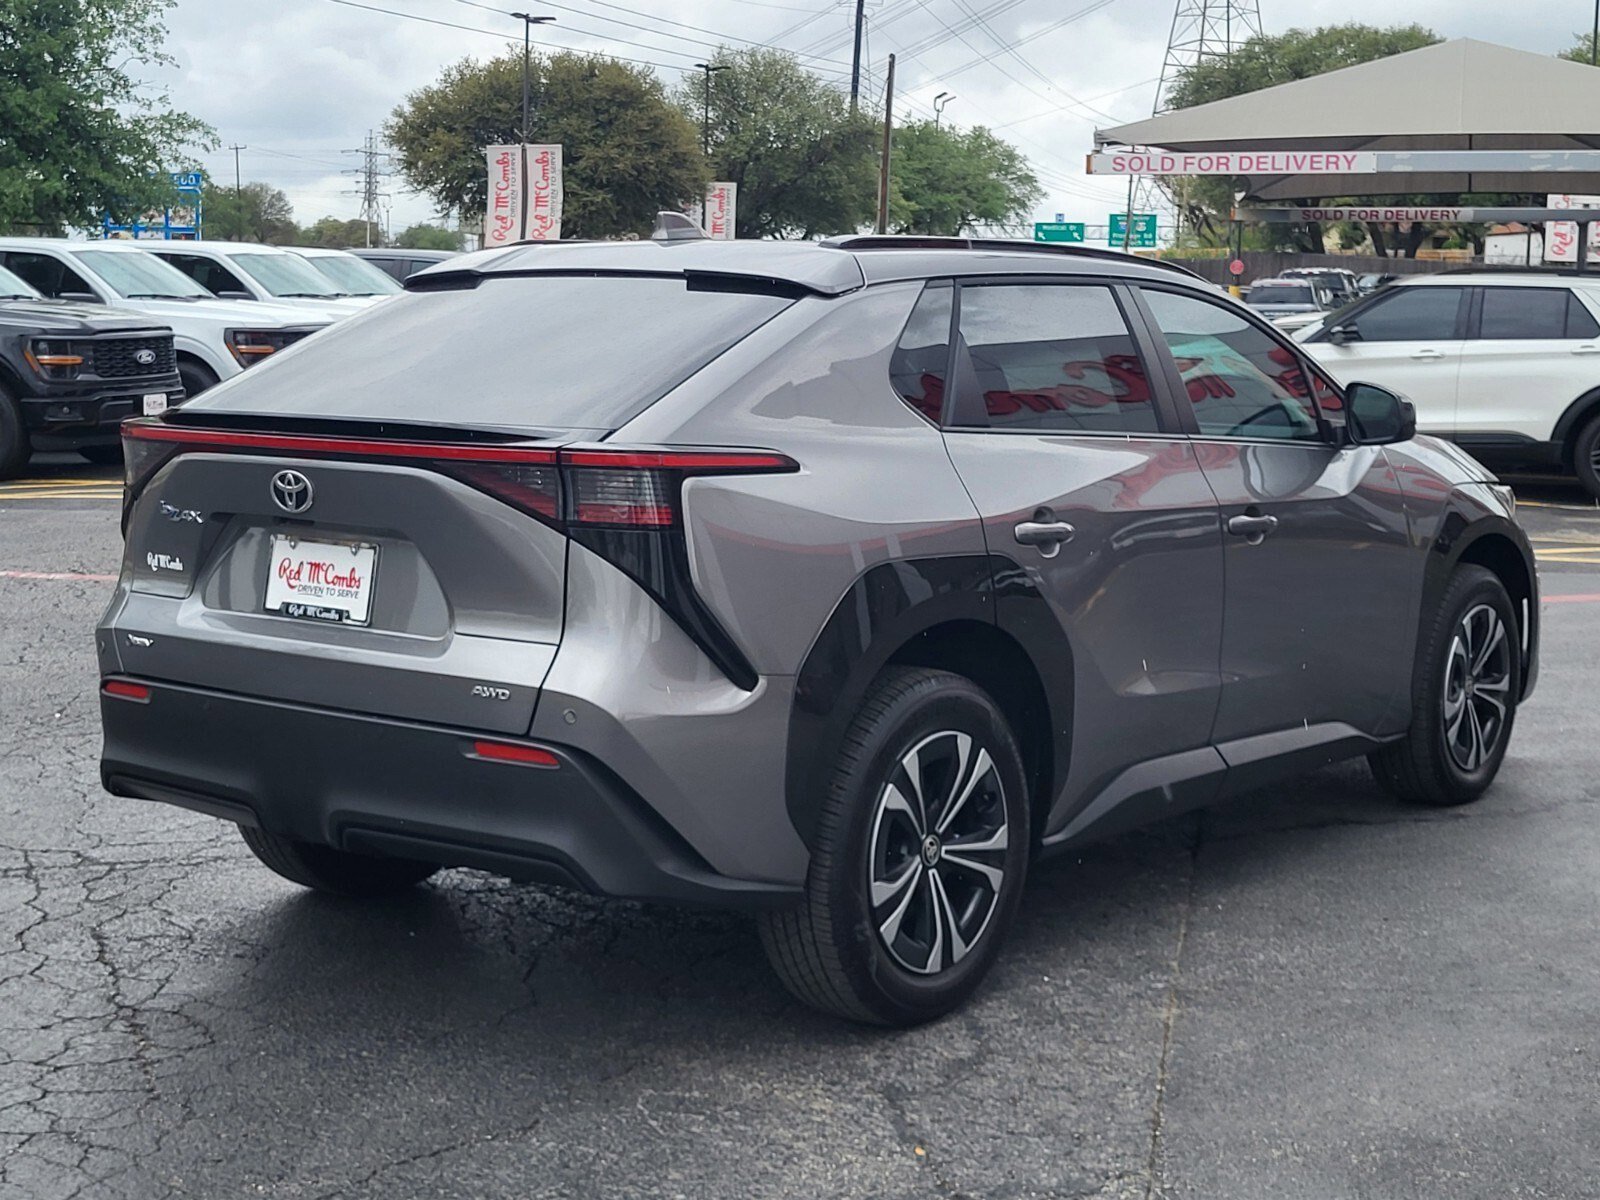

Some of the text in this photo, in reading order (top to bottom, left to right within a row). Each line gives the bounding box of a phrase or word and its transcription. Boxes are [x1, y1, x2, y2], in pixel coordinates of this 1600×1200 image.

[1112, 154, 1358, 172] SOLD FOR DELIVERY
[510, 178, 517, 187] TO
[534, 151, 550, 212] McCombs
[550, 177, 557, 187] TO
[491, 152, 513, 241] Red McCombs
[1301, 209, 1462, 221] SOLD FOR DELIVERY
[278, 557, 361, 590] Red McCombs
[297, 585, 360, 600] DRIVEN TO SERVE
[288, 604, 339, 621] Red McCombs
[471, 685, 511, 700] AWD
